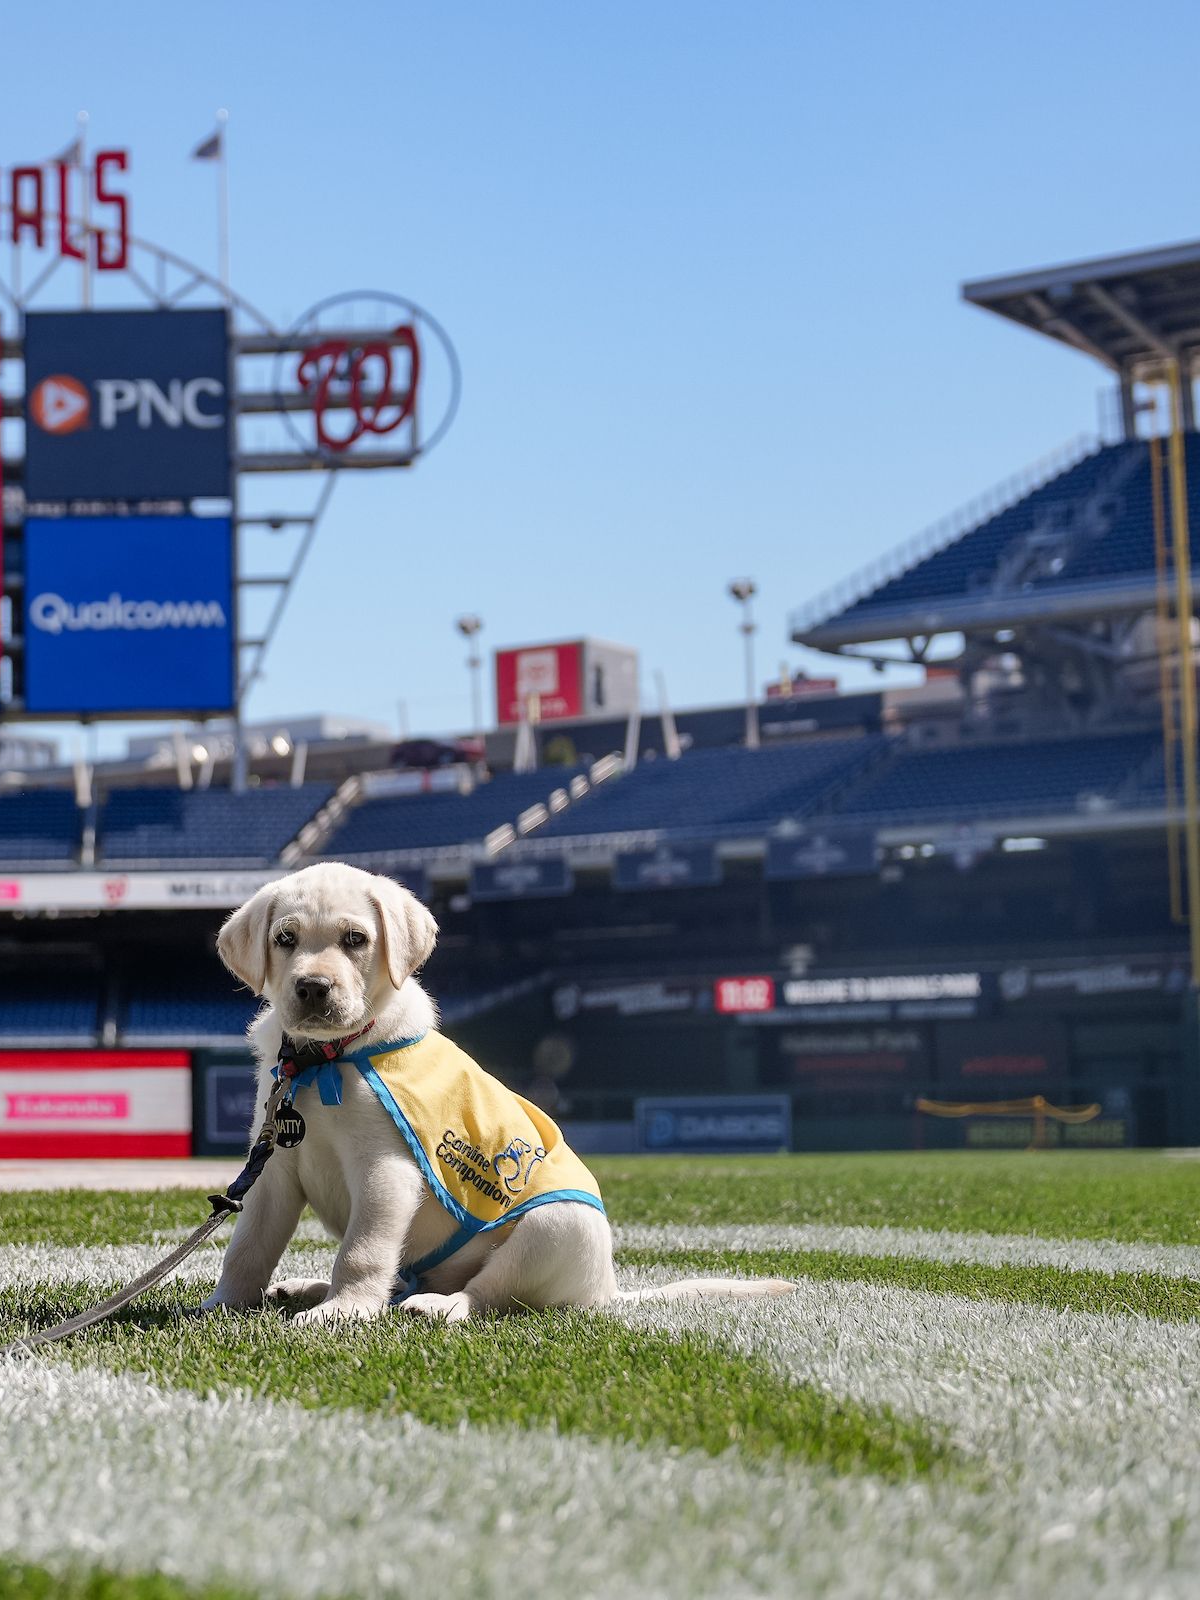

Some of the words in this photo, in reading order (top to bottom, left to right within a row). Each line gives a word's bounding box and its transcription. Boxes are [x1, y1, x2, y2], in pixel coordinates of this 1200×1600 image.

[96, 377, 225, 430] PNC
[29, 592, 227, 634] Qualcomm
[274, 1119, 301, 1134] NATTY
[443, 1130, 490, 1172] Canine
